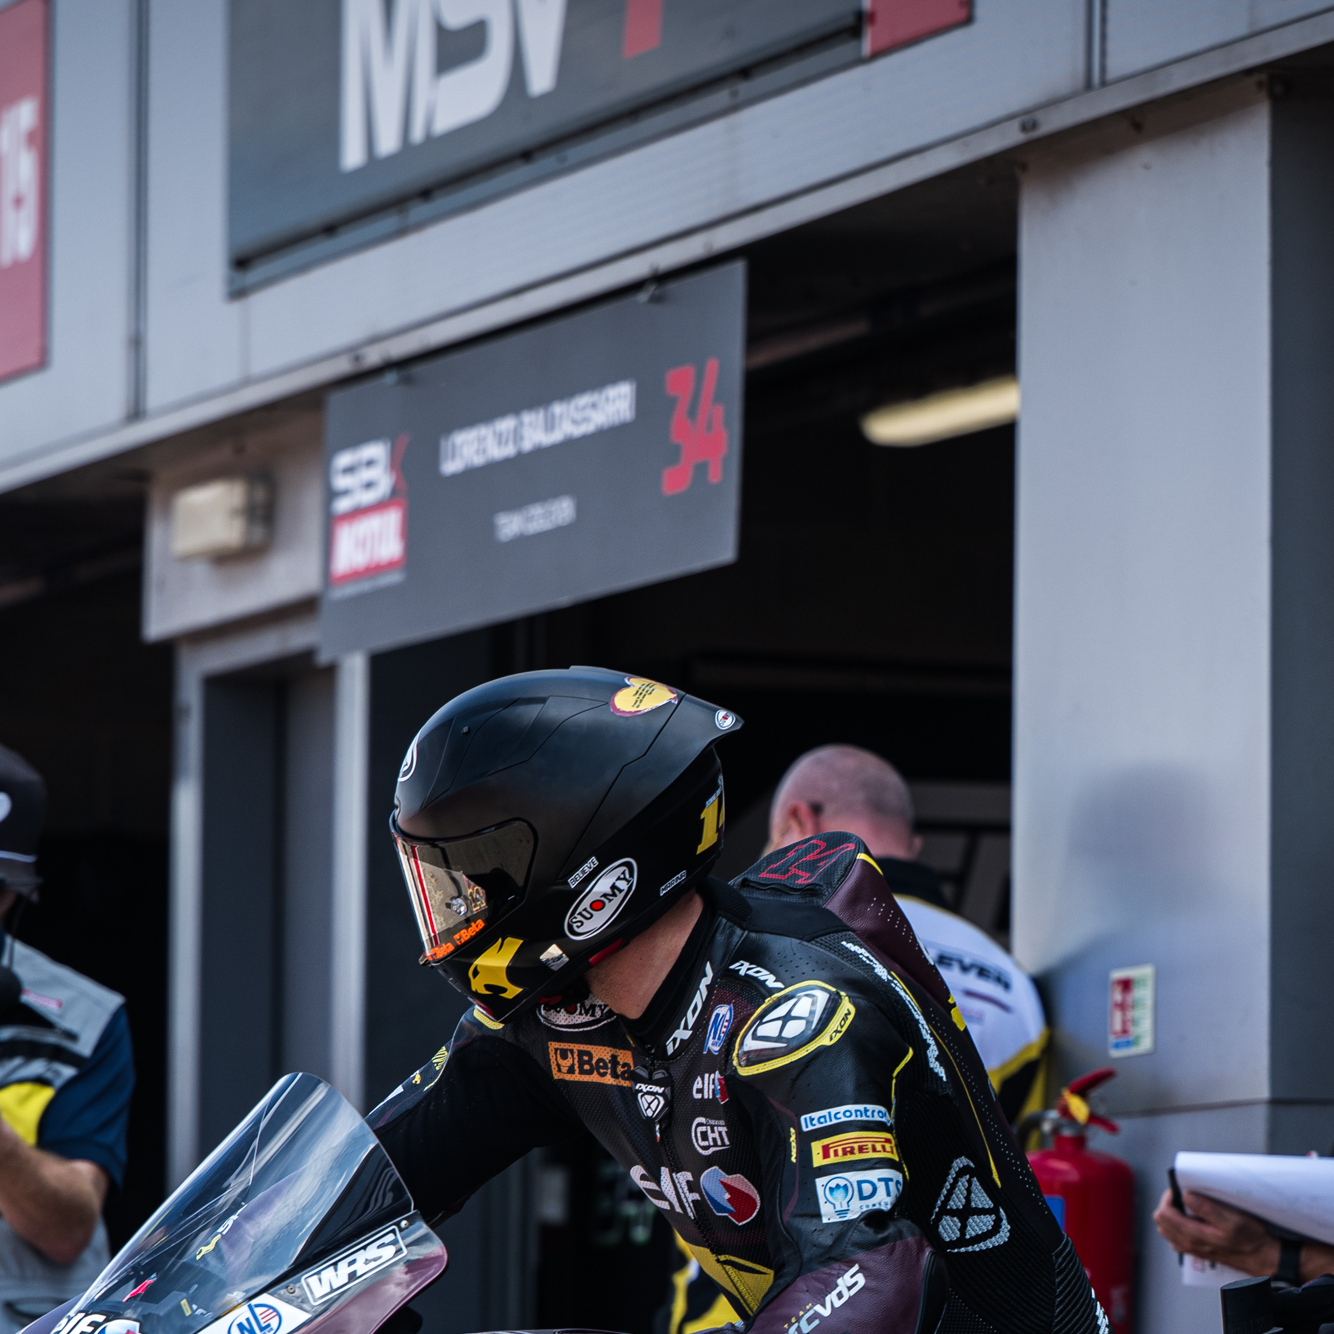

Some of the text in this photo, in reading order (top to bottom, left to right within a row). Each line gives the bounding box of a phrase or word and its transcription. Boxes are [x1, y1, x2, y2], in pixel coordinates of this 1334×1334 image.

[662, 357, 728, 496] 34
[568, 857, 598, 888] BELIEVE
[660, 871, 687, 896] MARINA
[569, 869, 633, 930] SUOMY
[462, 919, 486, 943] Beta
[577, 1050, 632, 1082] Beta
[692, 1072, 718, 1100] elf
[821, 1136, 896, 1161] PIRELLI
[629, 1164, 702, 1220] elf
[305, 1232, 397, 1300] WRS
